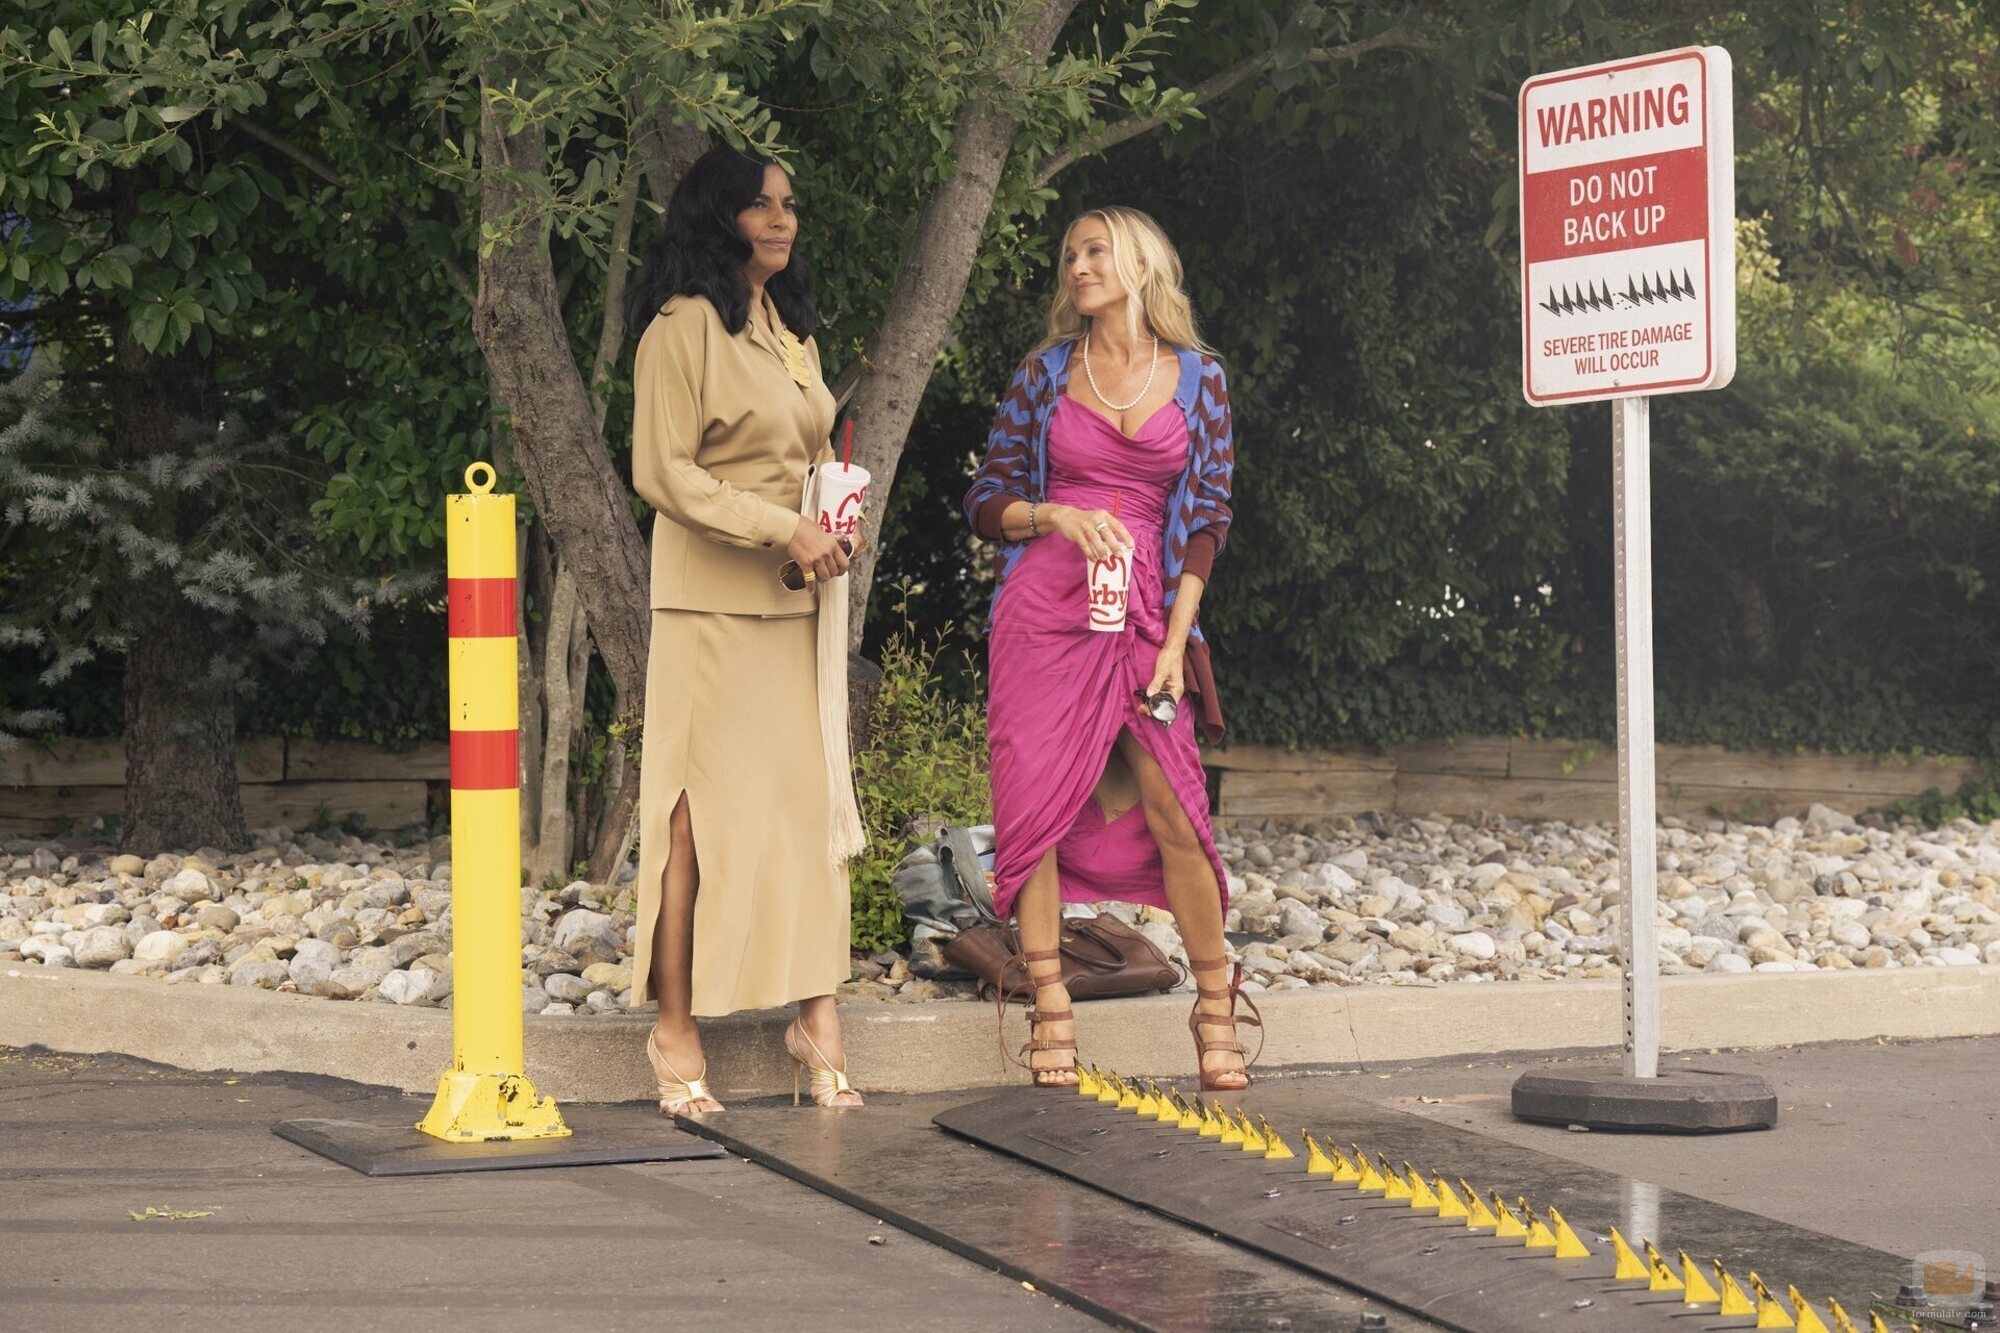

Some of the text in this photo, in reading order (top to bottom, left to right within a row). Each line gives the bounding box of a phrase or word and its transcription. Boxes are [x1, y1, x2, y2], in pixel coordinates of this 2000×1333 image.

[1536, 83, 1689, 148] WARNING
[1569, 166, 1658, 206] DO NOT
[1563, 204, 1666, 246] BACK UP
[1543, 322, 1693, 357] SEVERE TIRE DAMAGE
[1574, 349, 1659, 375] WILL OCCUR
